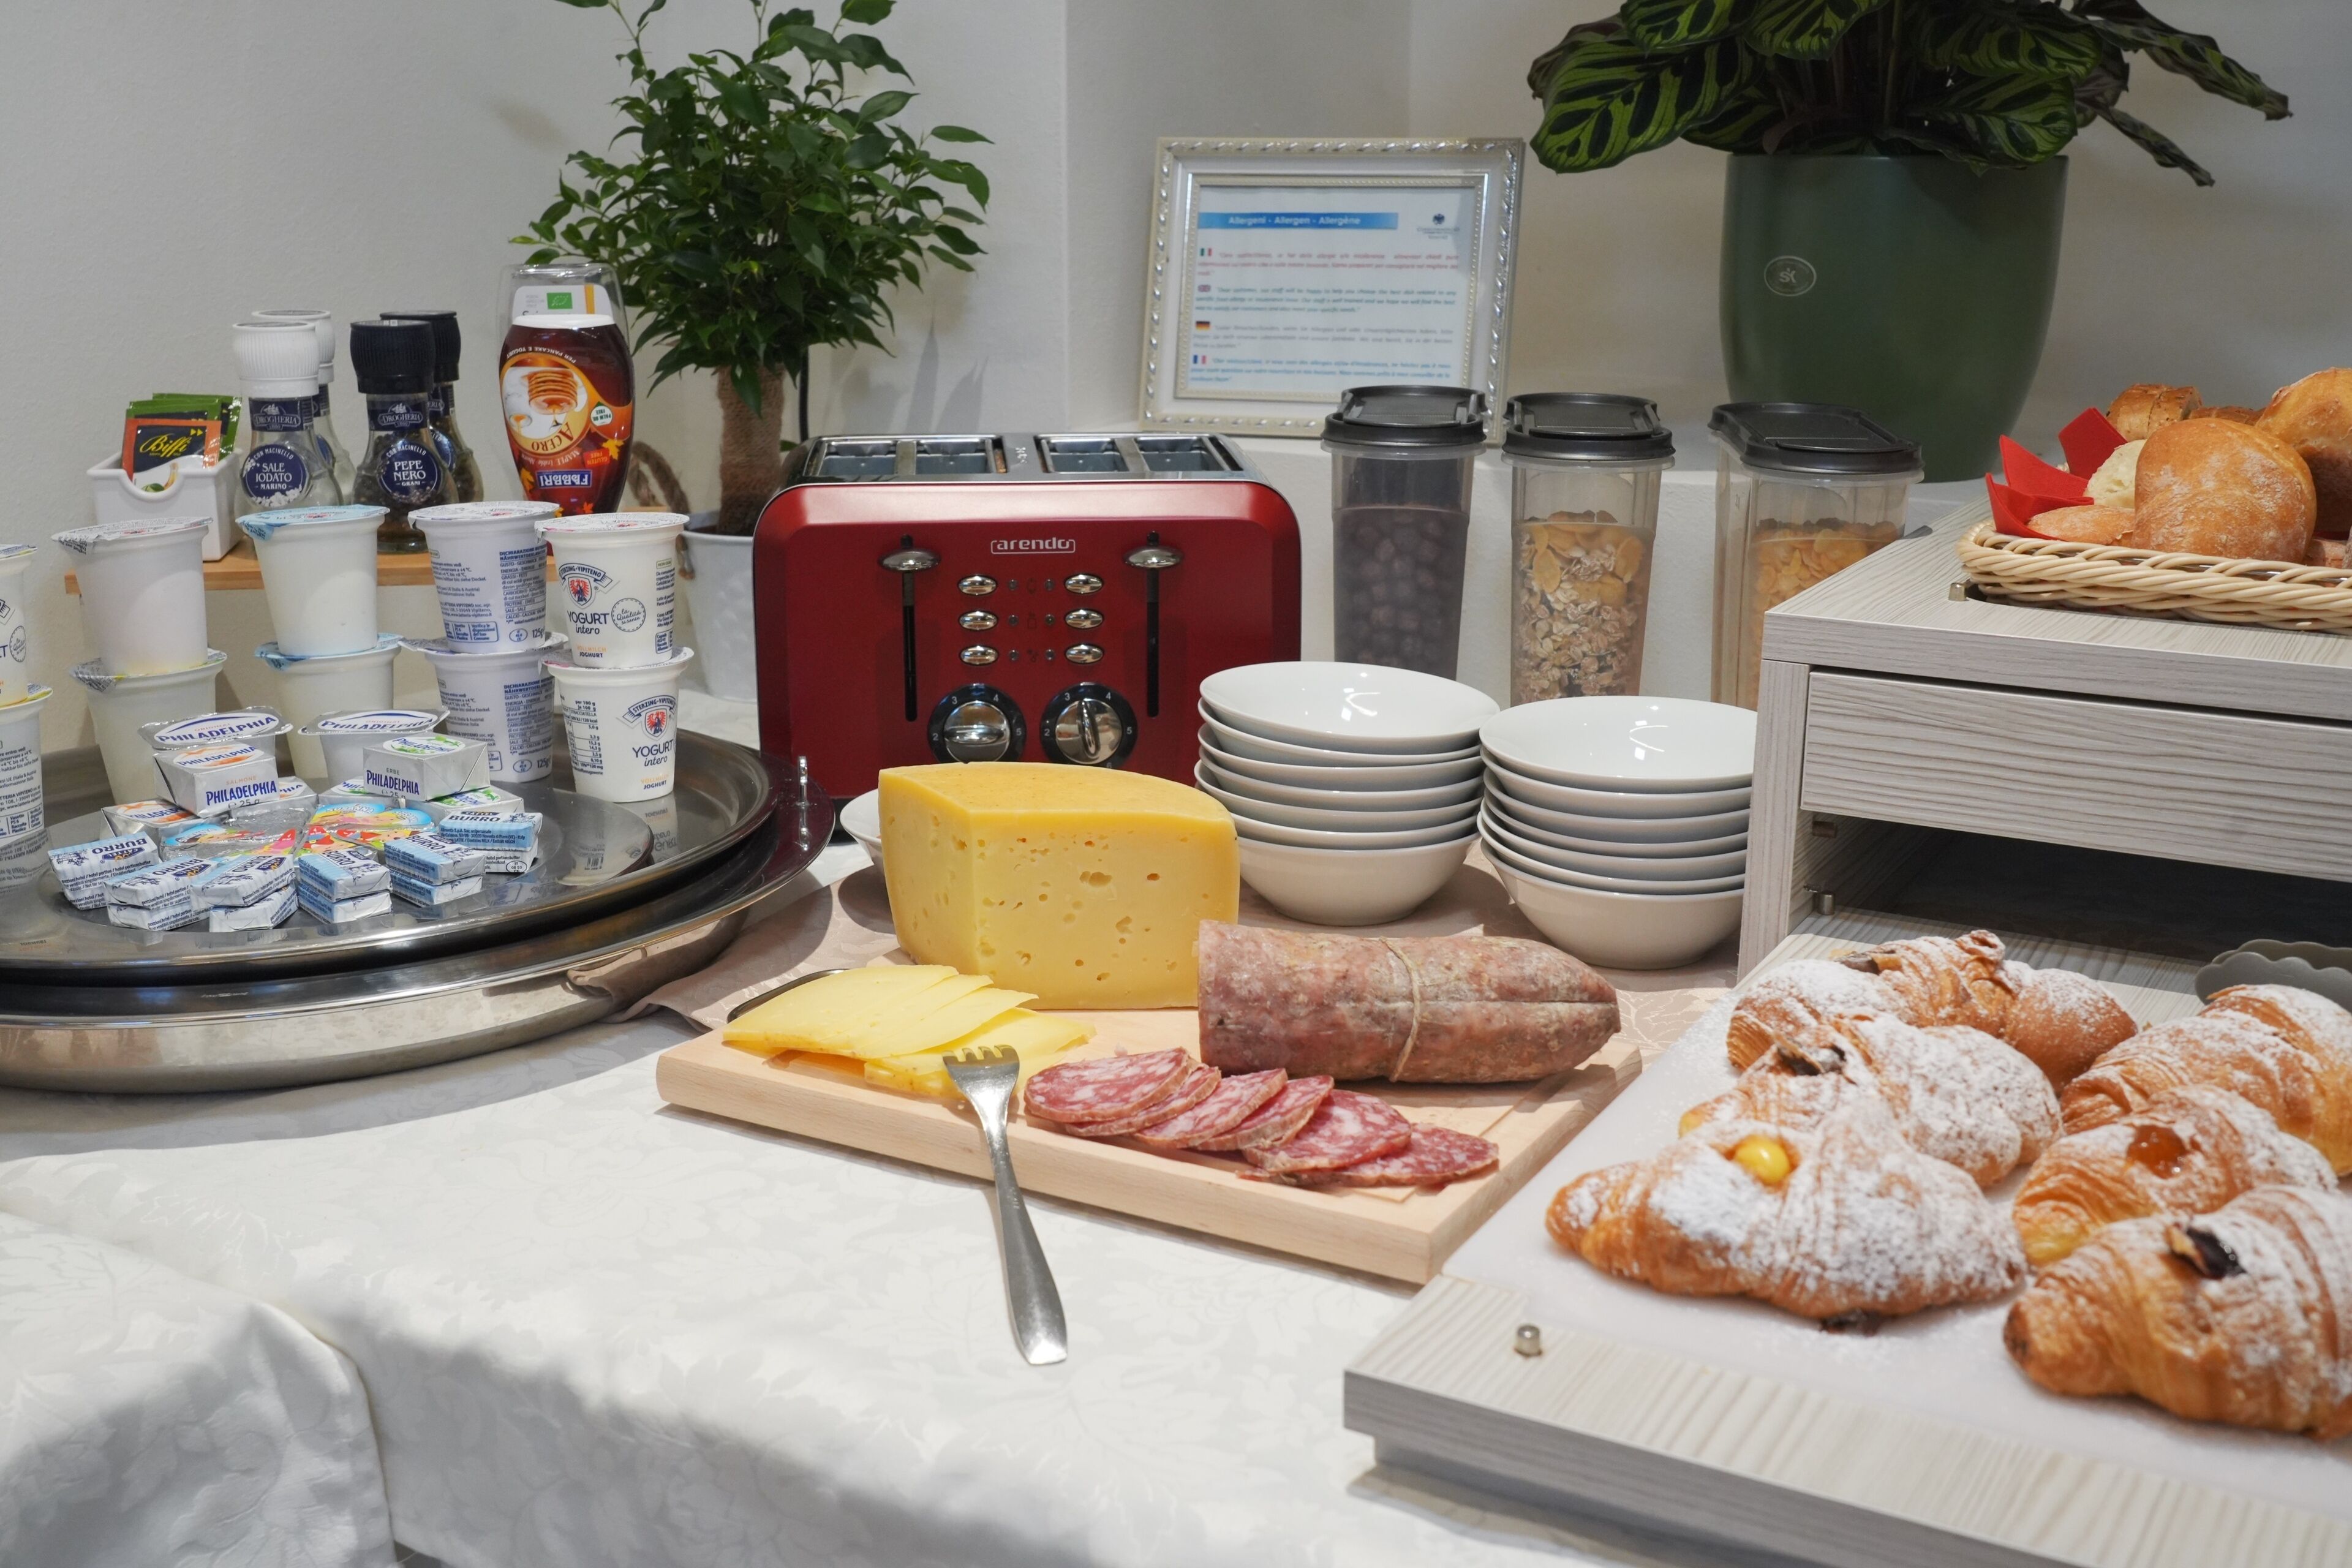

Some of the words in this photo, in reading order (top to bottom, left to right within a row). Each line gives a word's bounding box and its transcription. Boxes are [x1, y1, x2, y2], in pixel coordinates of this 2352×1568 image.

[1228, 216, 1266, 226] Allergeni
[1275, 216, 1310, 226] Allergen
[507, 347, 527, 360] YOGURT
[535, 346, 564, 358] PANCAKE
[564, 352, 576, 364] PER
[255, 416, 297, 425] DROGHERIA
[382, 413, 420, 423] DROGHERIA
[531, 422, 574, 451] ACERO
[140, 433, 192, 458] Biffi
[398, 444, 427, 456] MACINELLO
[254, 450, 263, 460] CON
[265, 447, 294, 460] MACINELLO
[262, 462, 285, 472] SALE
[394, 460, 423, 471] PEPE
[586, 455, 610, 466] GLUTEN
[255, 473, 292, 483] IODATO
[393, 470, 426, 481] NERO
[997, 537, 1069, 550] arendo
[567, 611, 609, 625] YOGURT
[576, 624, 600, 635] intero
[156, 715, 277, 742] PHILADELPHIA
[320, 718, 433, 731] PHILADELPHIA
[632, 739, 674, 758] YOGURT
[178, 745, 257, 767] PHILADELPHIA
[644, 756, 668, 767] intero
[225, 775, 257, 785] SALMONE
[366, 769, 420, 796] PHILADELPHIA
[644, 780, 667, 790] JOGHURT
[205, 780, 277, 806] PHILADELPHIA
[92, 838, 148, 854] BURRO
[406, 835, 446, 850] BURRO
[232, 855, 273, 872] BURRO
[323, 850, 356, 865] BURRO
[153, 859, 204, 875] BURRO
